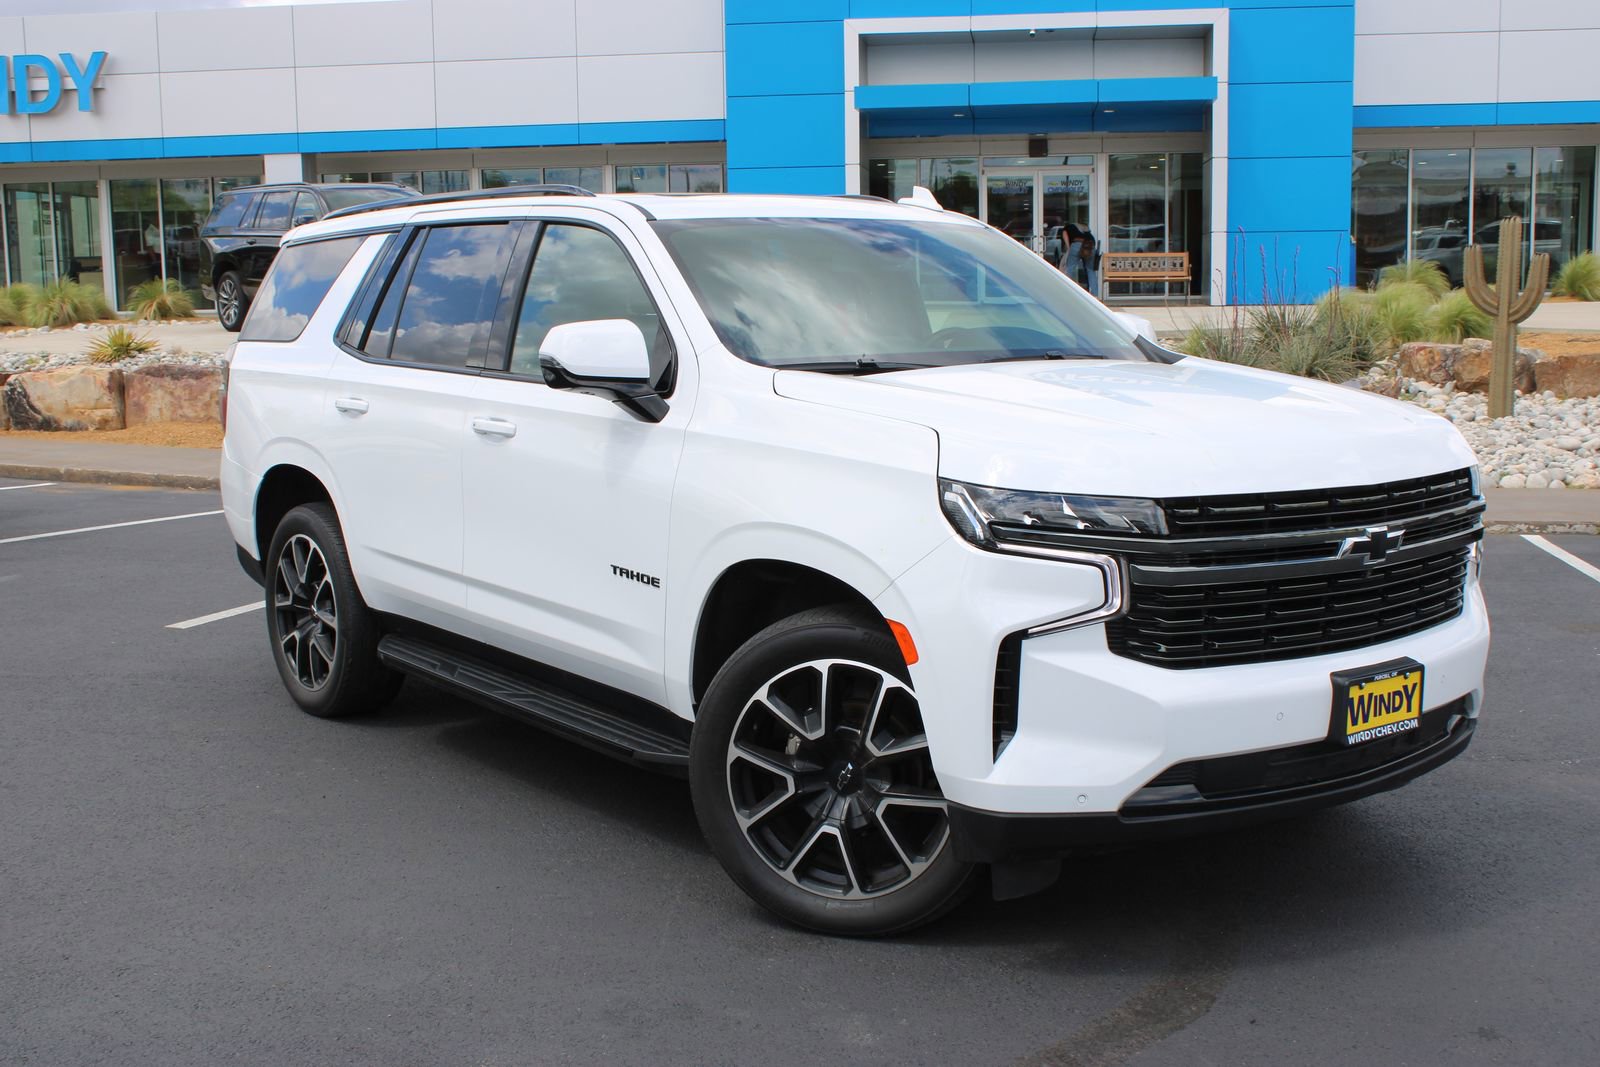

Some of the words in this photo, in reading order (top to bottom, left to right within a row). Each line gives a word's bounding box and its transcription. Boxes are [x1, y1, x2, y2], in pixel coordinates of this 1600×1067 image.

[1060, 179, 1084, 187] WINDY
[1110, 260, 1184, 269] CHEVROLET
[610, 564, 661, 588] TAHOE
[1347, 682, 1418, 727] WINDY
